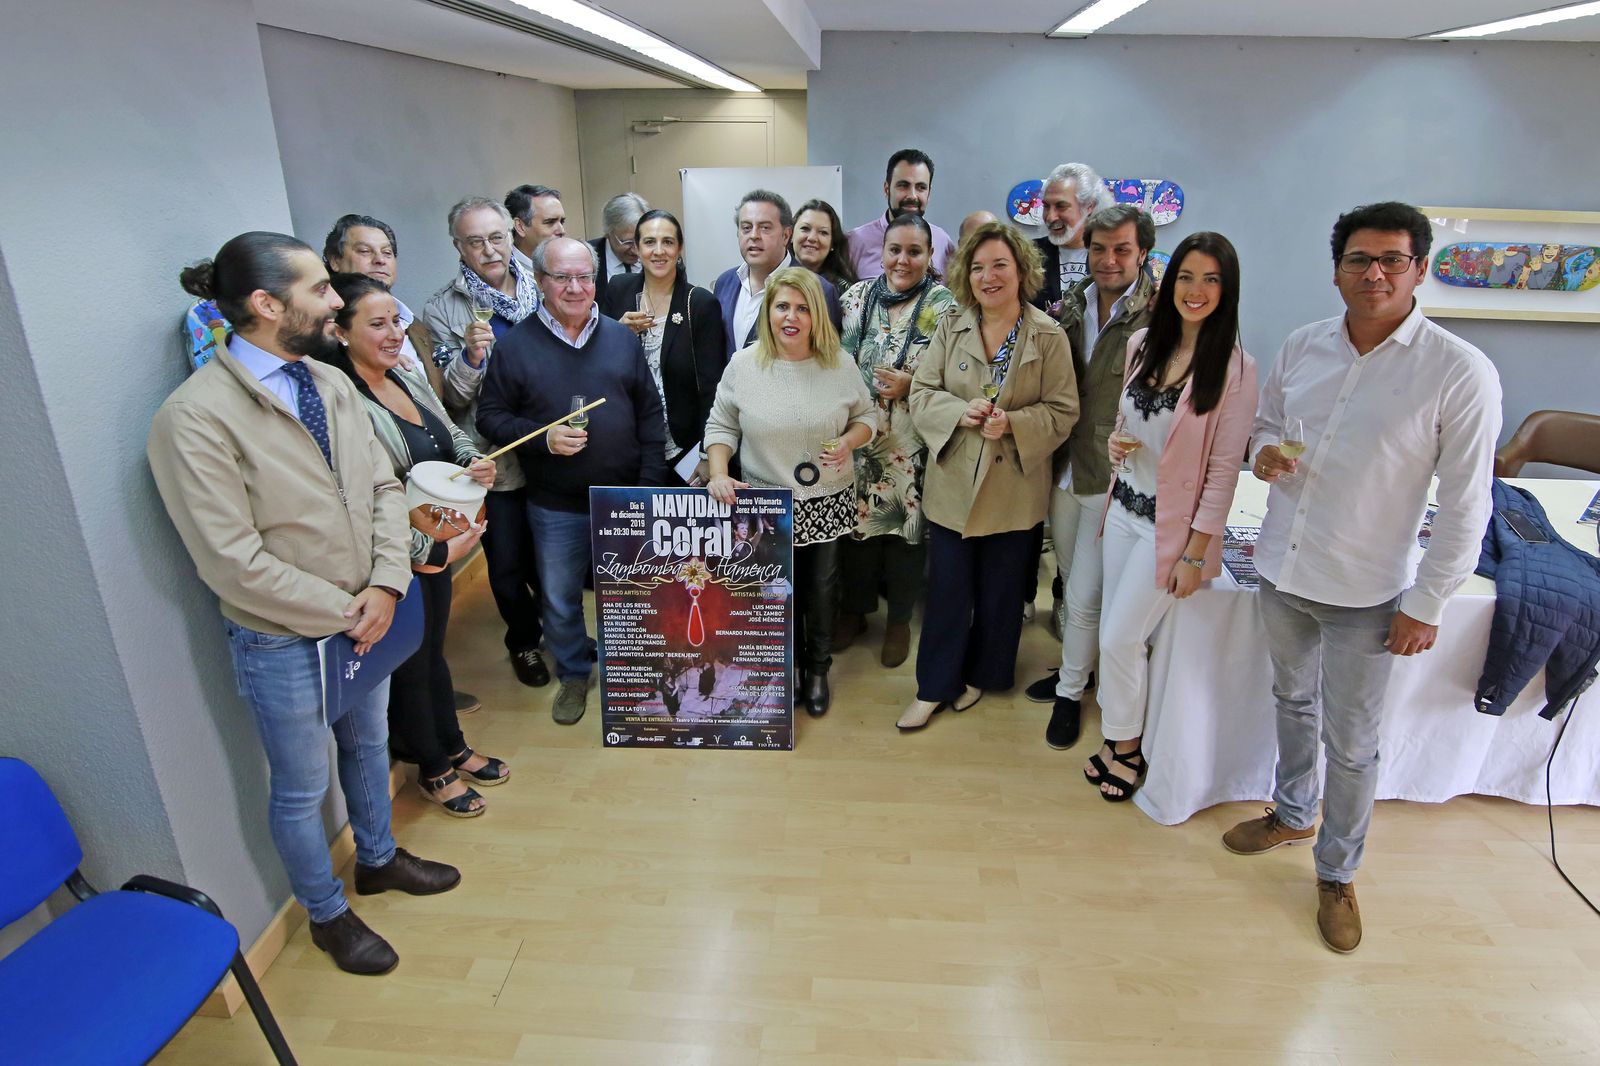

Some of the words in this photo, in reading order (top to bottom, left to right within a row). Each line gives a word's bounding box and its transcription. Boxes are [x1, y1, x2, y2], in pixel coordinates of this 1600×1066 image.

[640, 502, 644, 510] 6
[652, 494, 731, 518] NAVIDAD
[736, 497, 752, 506] Teatro
[754, 497, 782, 506] Villamarta
[736, 506, 750, 514] Jerez
[750, 506, 758, 514] de
[687, 517, 696, 526] de
[652, 519, 732, 557] Coral
[596, 540, 692, 582] Zambomba
[704, 541, 787, 583] Flamenca
